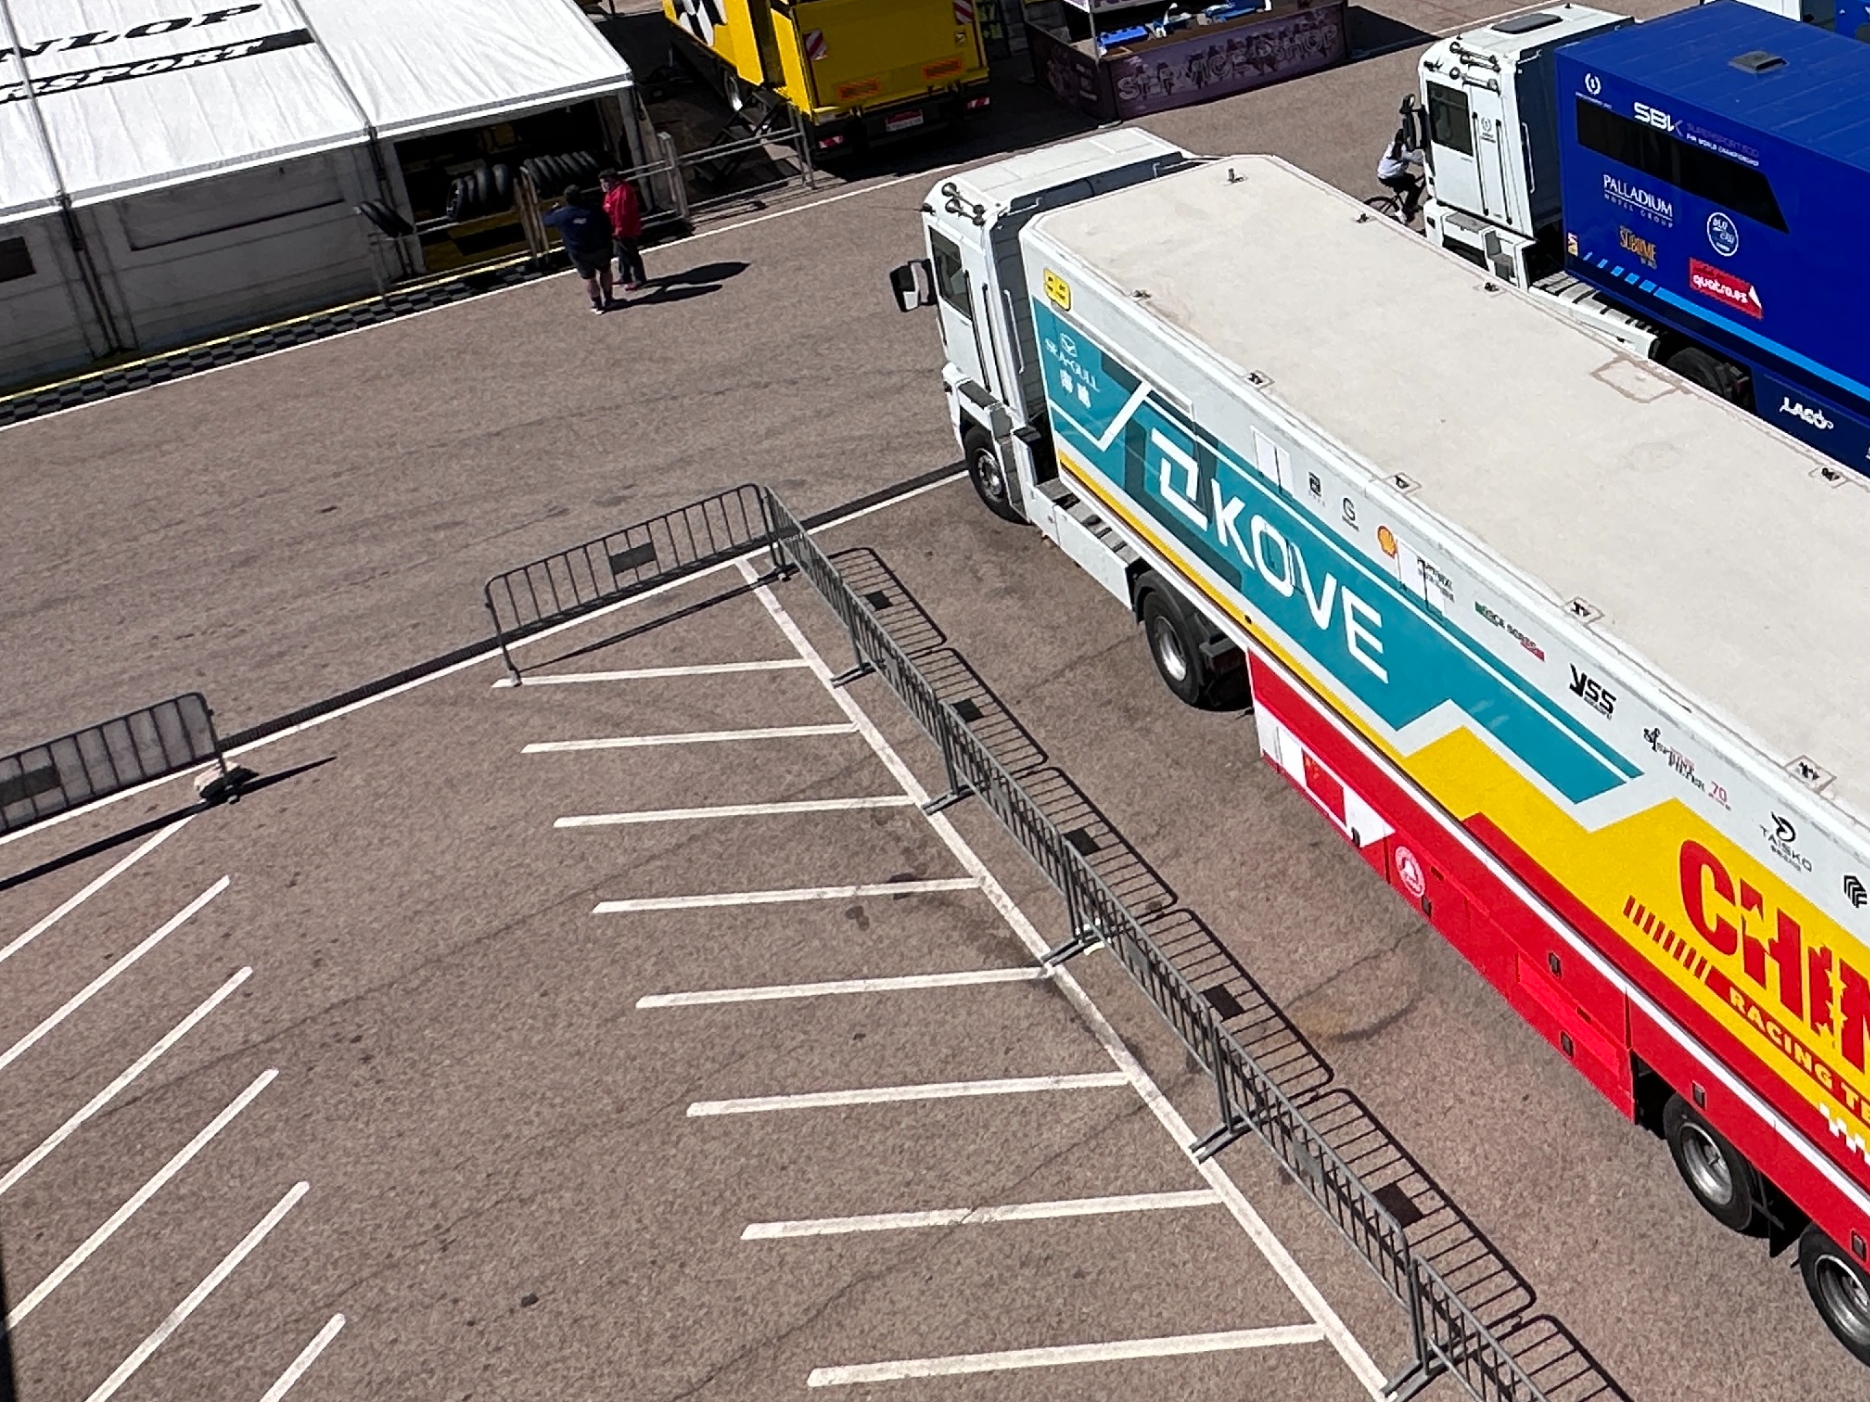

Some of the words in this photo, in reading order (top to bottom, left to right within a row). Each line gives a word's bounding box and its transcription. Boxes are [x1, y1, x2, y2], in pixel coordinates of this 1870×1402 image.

[1634, 101, 1683, 138] SBK
[1603, 174, 1673, 217] PALLADIUM
[1640, 209, 1674, 229] GROUP
[1211, 478, 1388, 684] KOVE
[1569, 663, 1617, 716] YSS
[1729, 987, 1832, 1088] RACING
